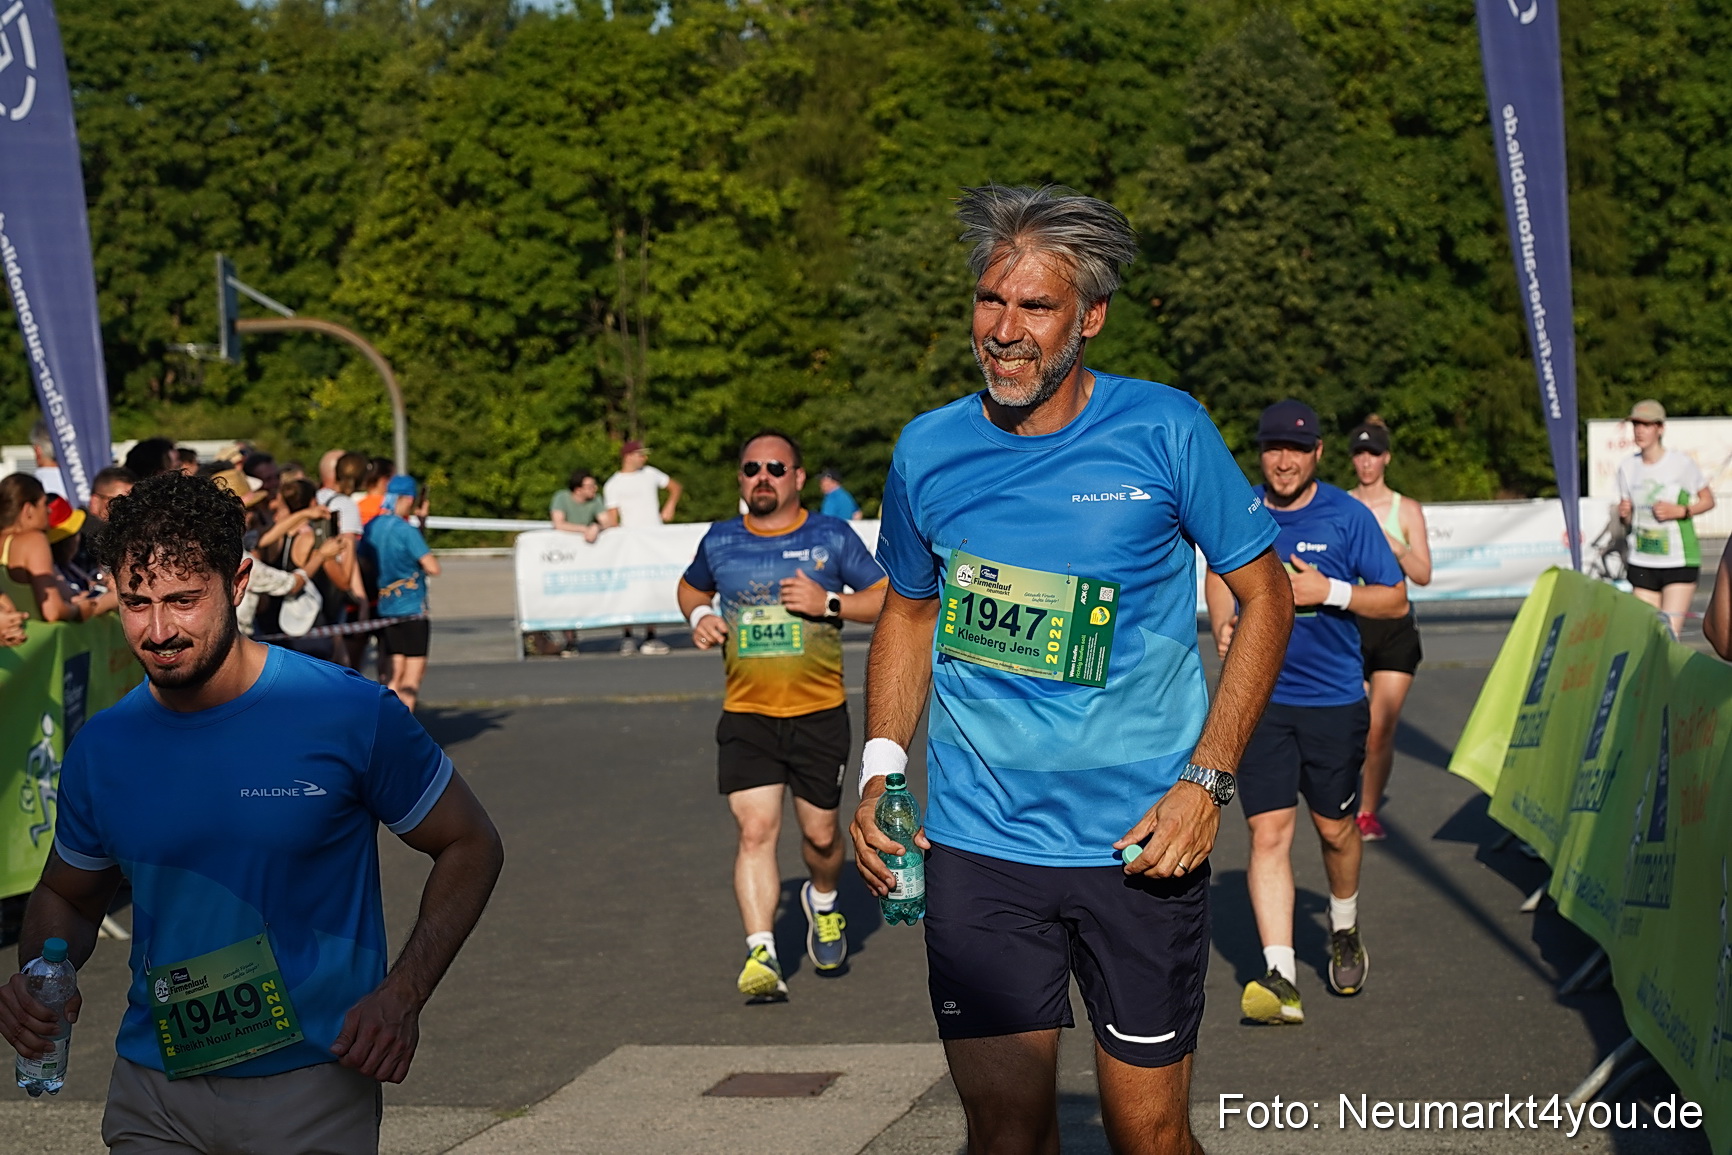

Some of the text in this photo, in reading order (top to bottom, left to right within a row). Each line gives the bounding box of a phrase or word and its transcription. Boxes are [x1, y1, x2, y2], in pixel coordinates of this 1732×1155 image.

[1072, 492, 1127, 503] RAILONE
[973, 577, 1012, 592] Firmenlauf
[1080, 590, 1088, 605] AOK
[752, 624, 785, 641] 644
[944, 597, 959, 635] RUN
[961, 592, 1048, 641] 1947
[957, 627, 1040, 657] Kleeberg Jens
[1045, 616, 1064, 665] 2022
[240, 787, 300, 798] RAILONE
[169, 975, 208, 995] Firmenlauf
[168, 982, 262, 1039] 1949
[261, 979, 290, 1031] 2022
[158, 1018, 177, 1057] RUN
[173, 1017, 274, 1055] Sheikh Nour Ammar
